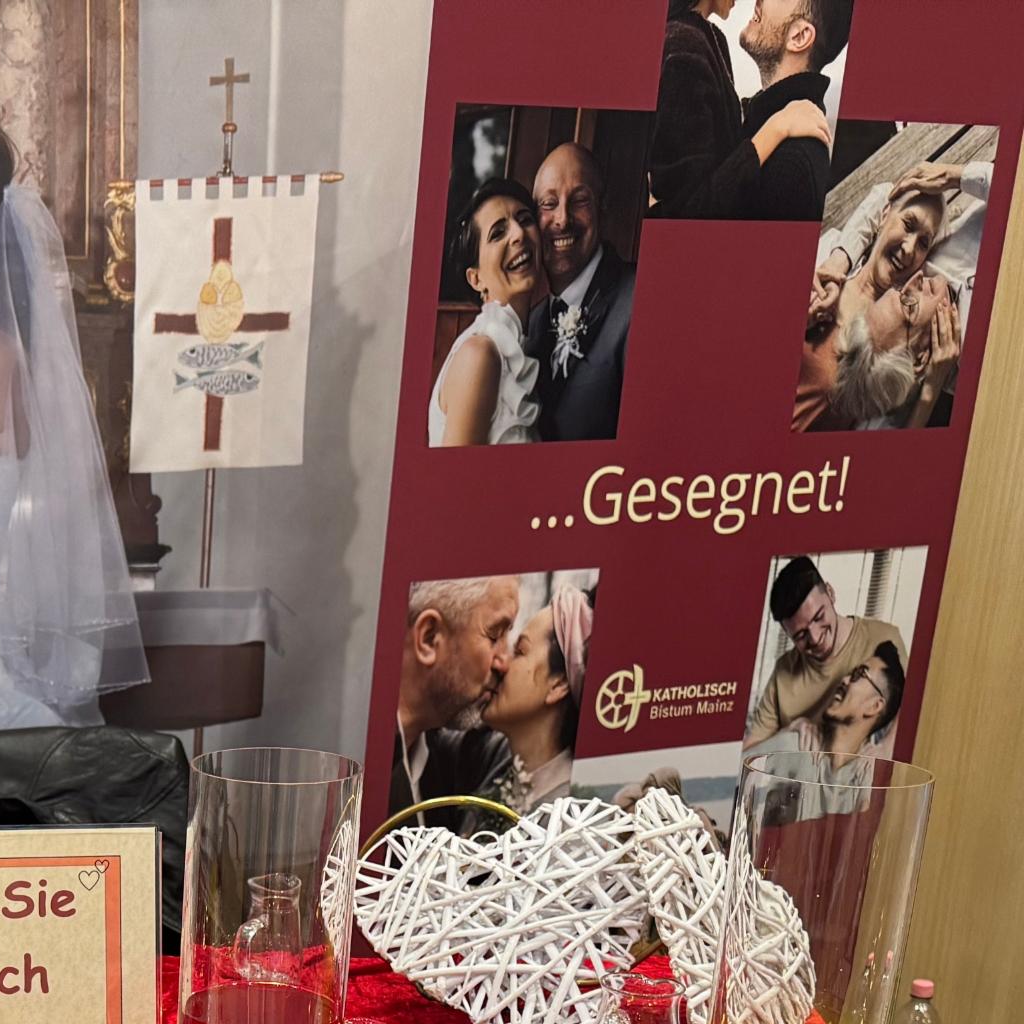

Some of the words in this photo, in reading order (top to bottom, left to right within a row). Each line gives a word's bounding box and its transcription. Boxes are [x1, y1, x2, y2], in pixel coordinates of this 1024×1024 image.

[530, 456, 851, 535] ...Gesegnet!
[652, 682, 738, 702] KATHOLISCH
[650, 704, 693, 720] Bistum
[696, 700, 734, 715] Mainz
[1, 878, 77, 919] Sie
